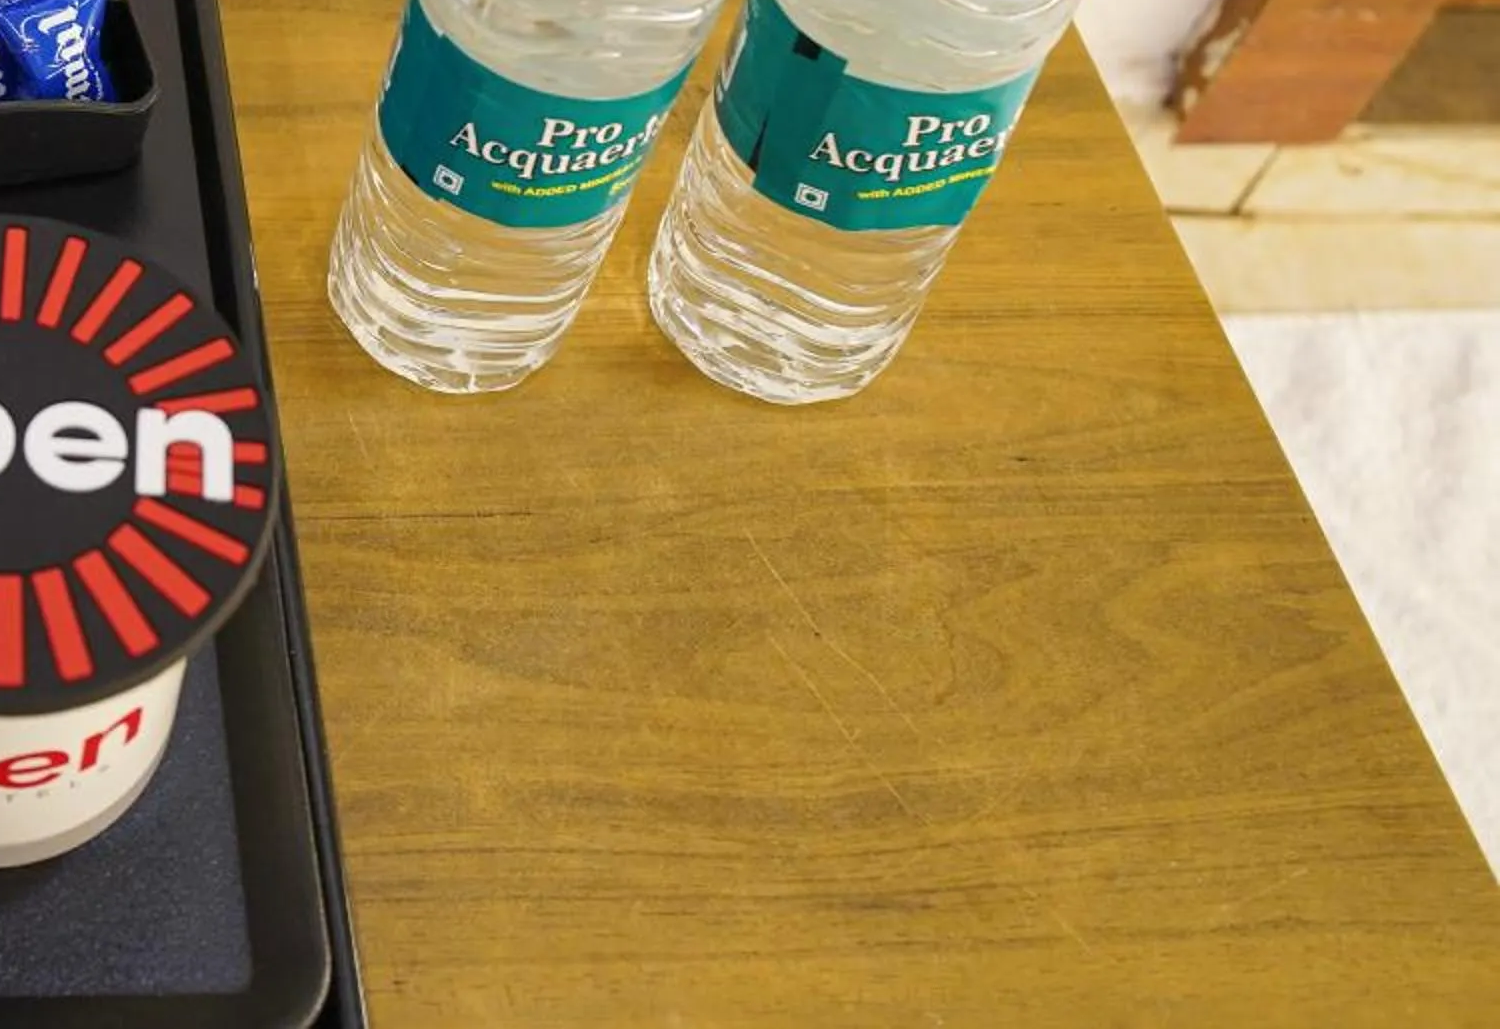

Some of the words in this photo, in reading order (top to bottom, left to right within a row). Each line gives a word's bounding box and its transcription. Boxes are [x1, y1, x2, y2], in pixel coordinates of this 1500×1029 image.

[536, 117, 623, 149] Pro
[902, 114, 991, 147] Pro
[523, 184, 577, 197] ADDED
[892, 178, 947, 197] ADDED
